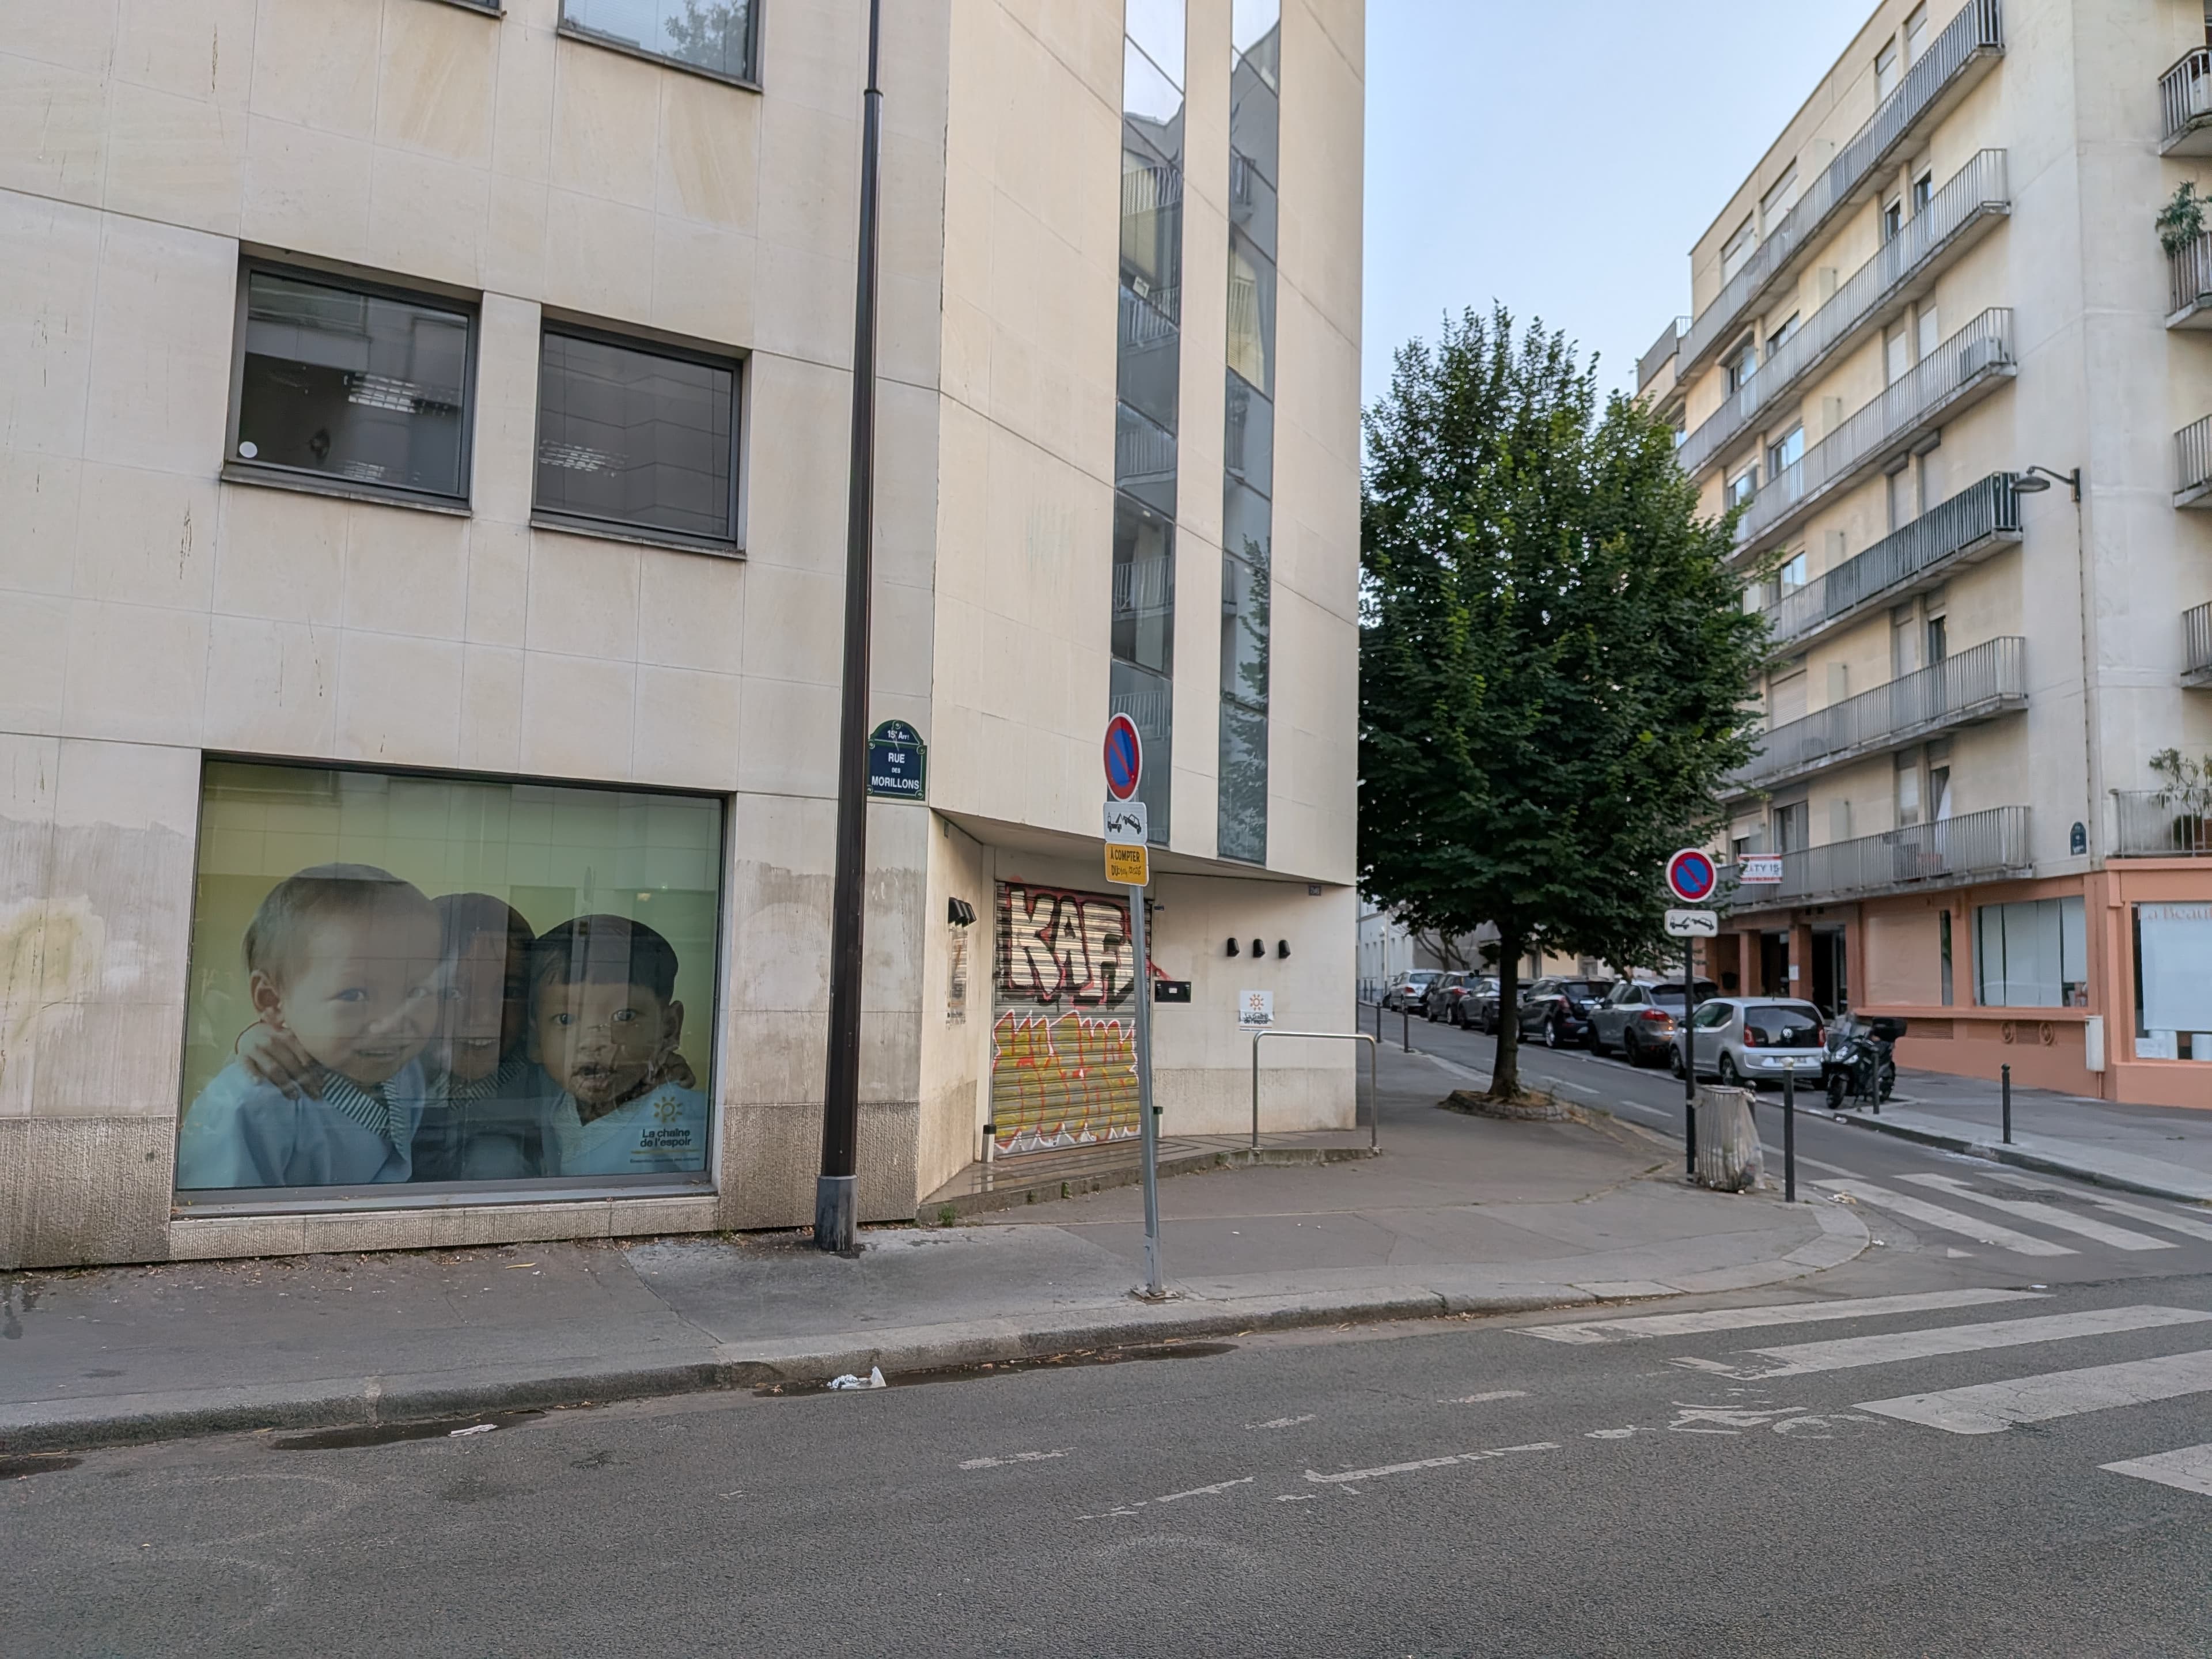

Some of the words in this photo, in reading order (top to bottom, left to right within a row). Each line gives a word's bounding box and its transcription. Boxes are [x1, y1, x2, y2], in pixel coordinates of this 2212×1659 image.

[888, 752, 905, 764] RUE
[871, 775, 920, 790] MORILLONS
[1115, 849, 1141, 862] COMPTER
[1111, 865, 1118, 876] DU
[642, 1128, 655, 1138] La
[657, 1127, 691, 1138] chaîne
[639, 1138, 653, 1147] de
[654, 1138, 692, 1148] l'espoir
